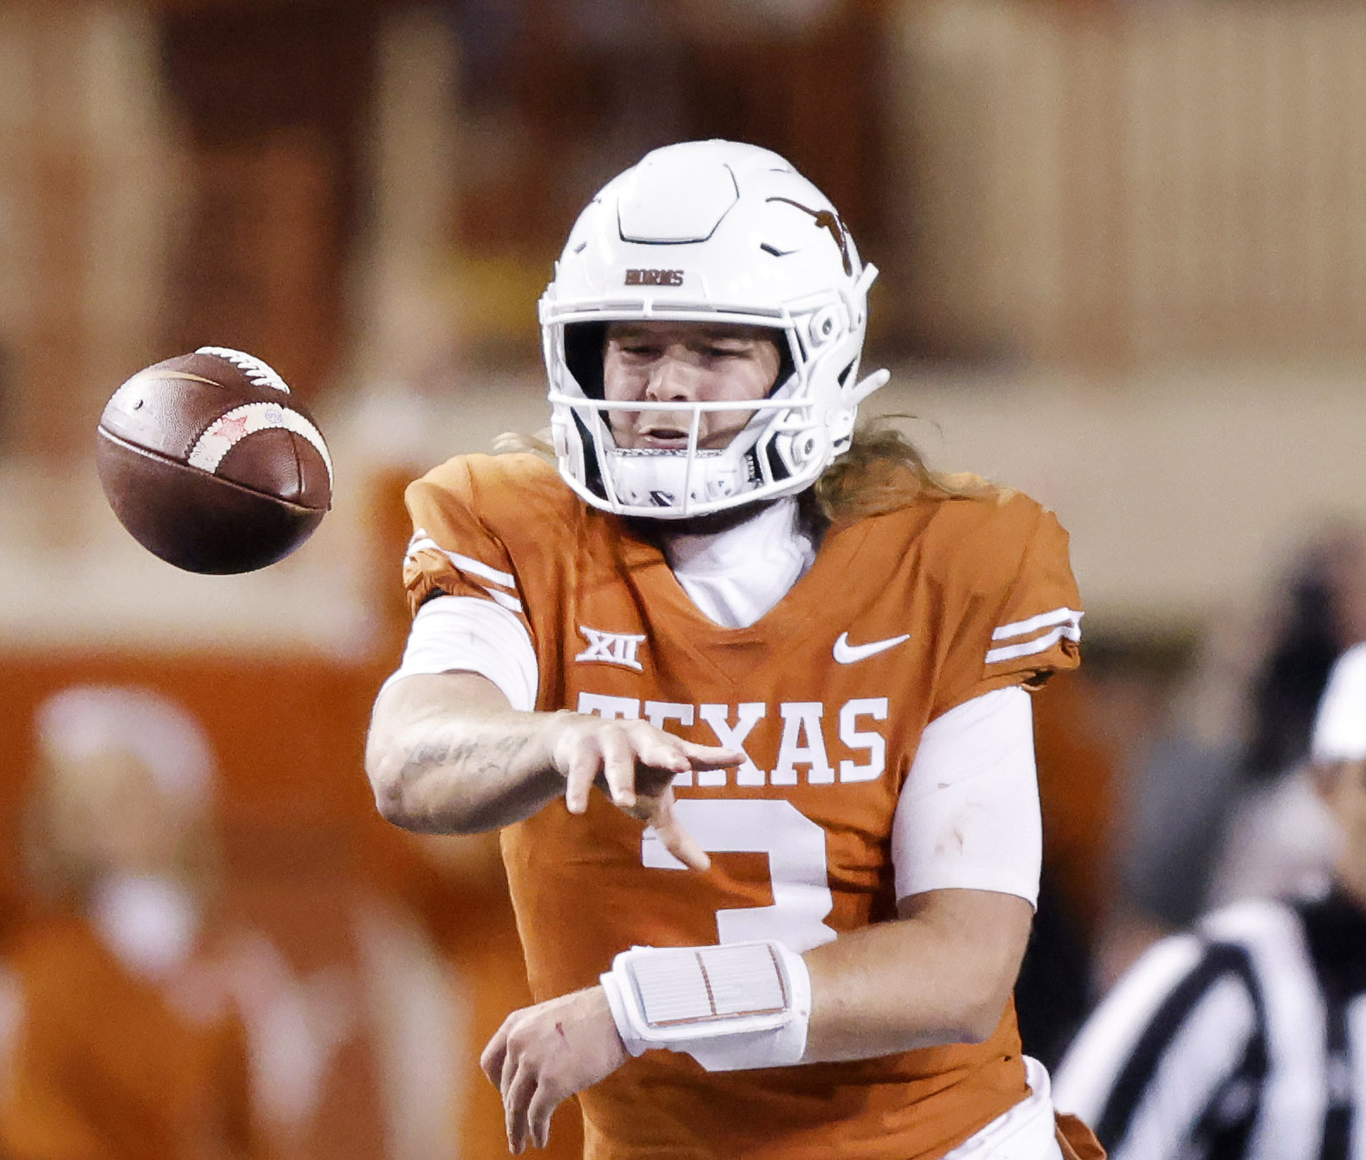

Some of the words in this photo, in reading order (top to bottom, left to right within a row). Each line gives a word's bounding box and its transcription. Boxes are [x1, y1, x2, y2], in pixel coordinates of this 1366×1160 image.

[624, 268, 685, 287] HORNS
[575, 626, 646, 671] XII
[641, 799, 838, 955] 3
